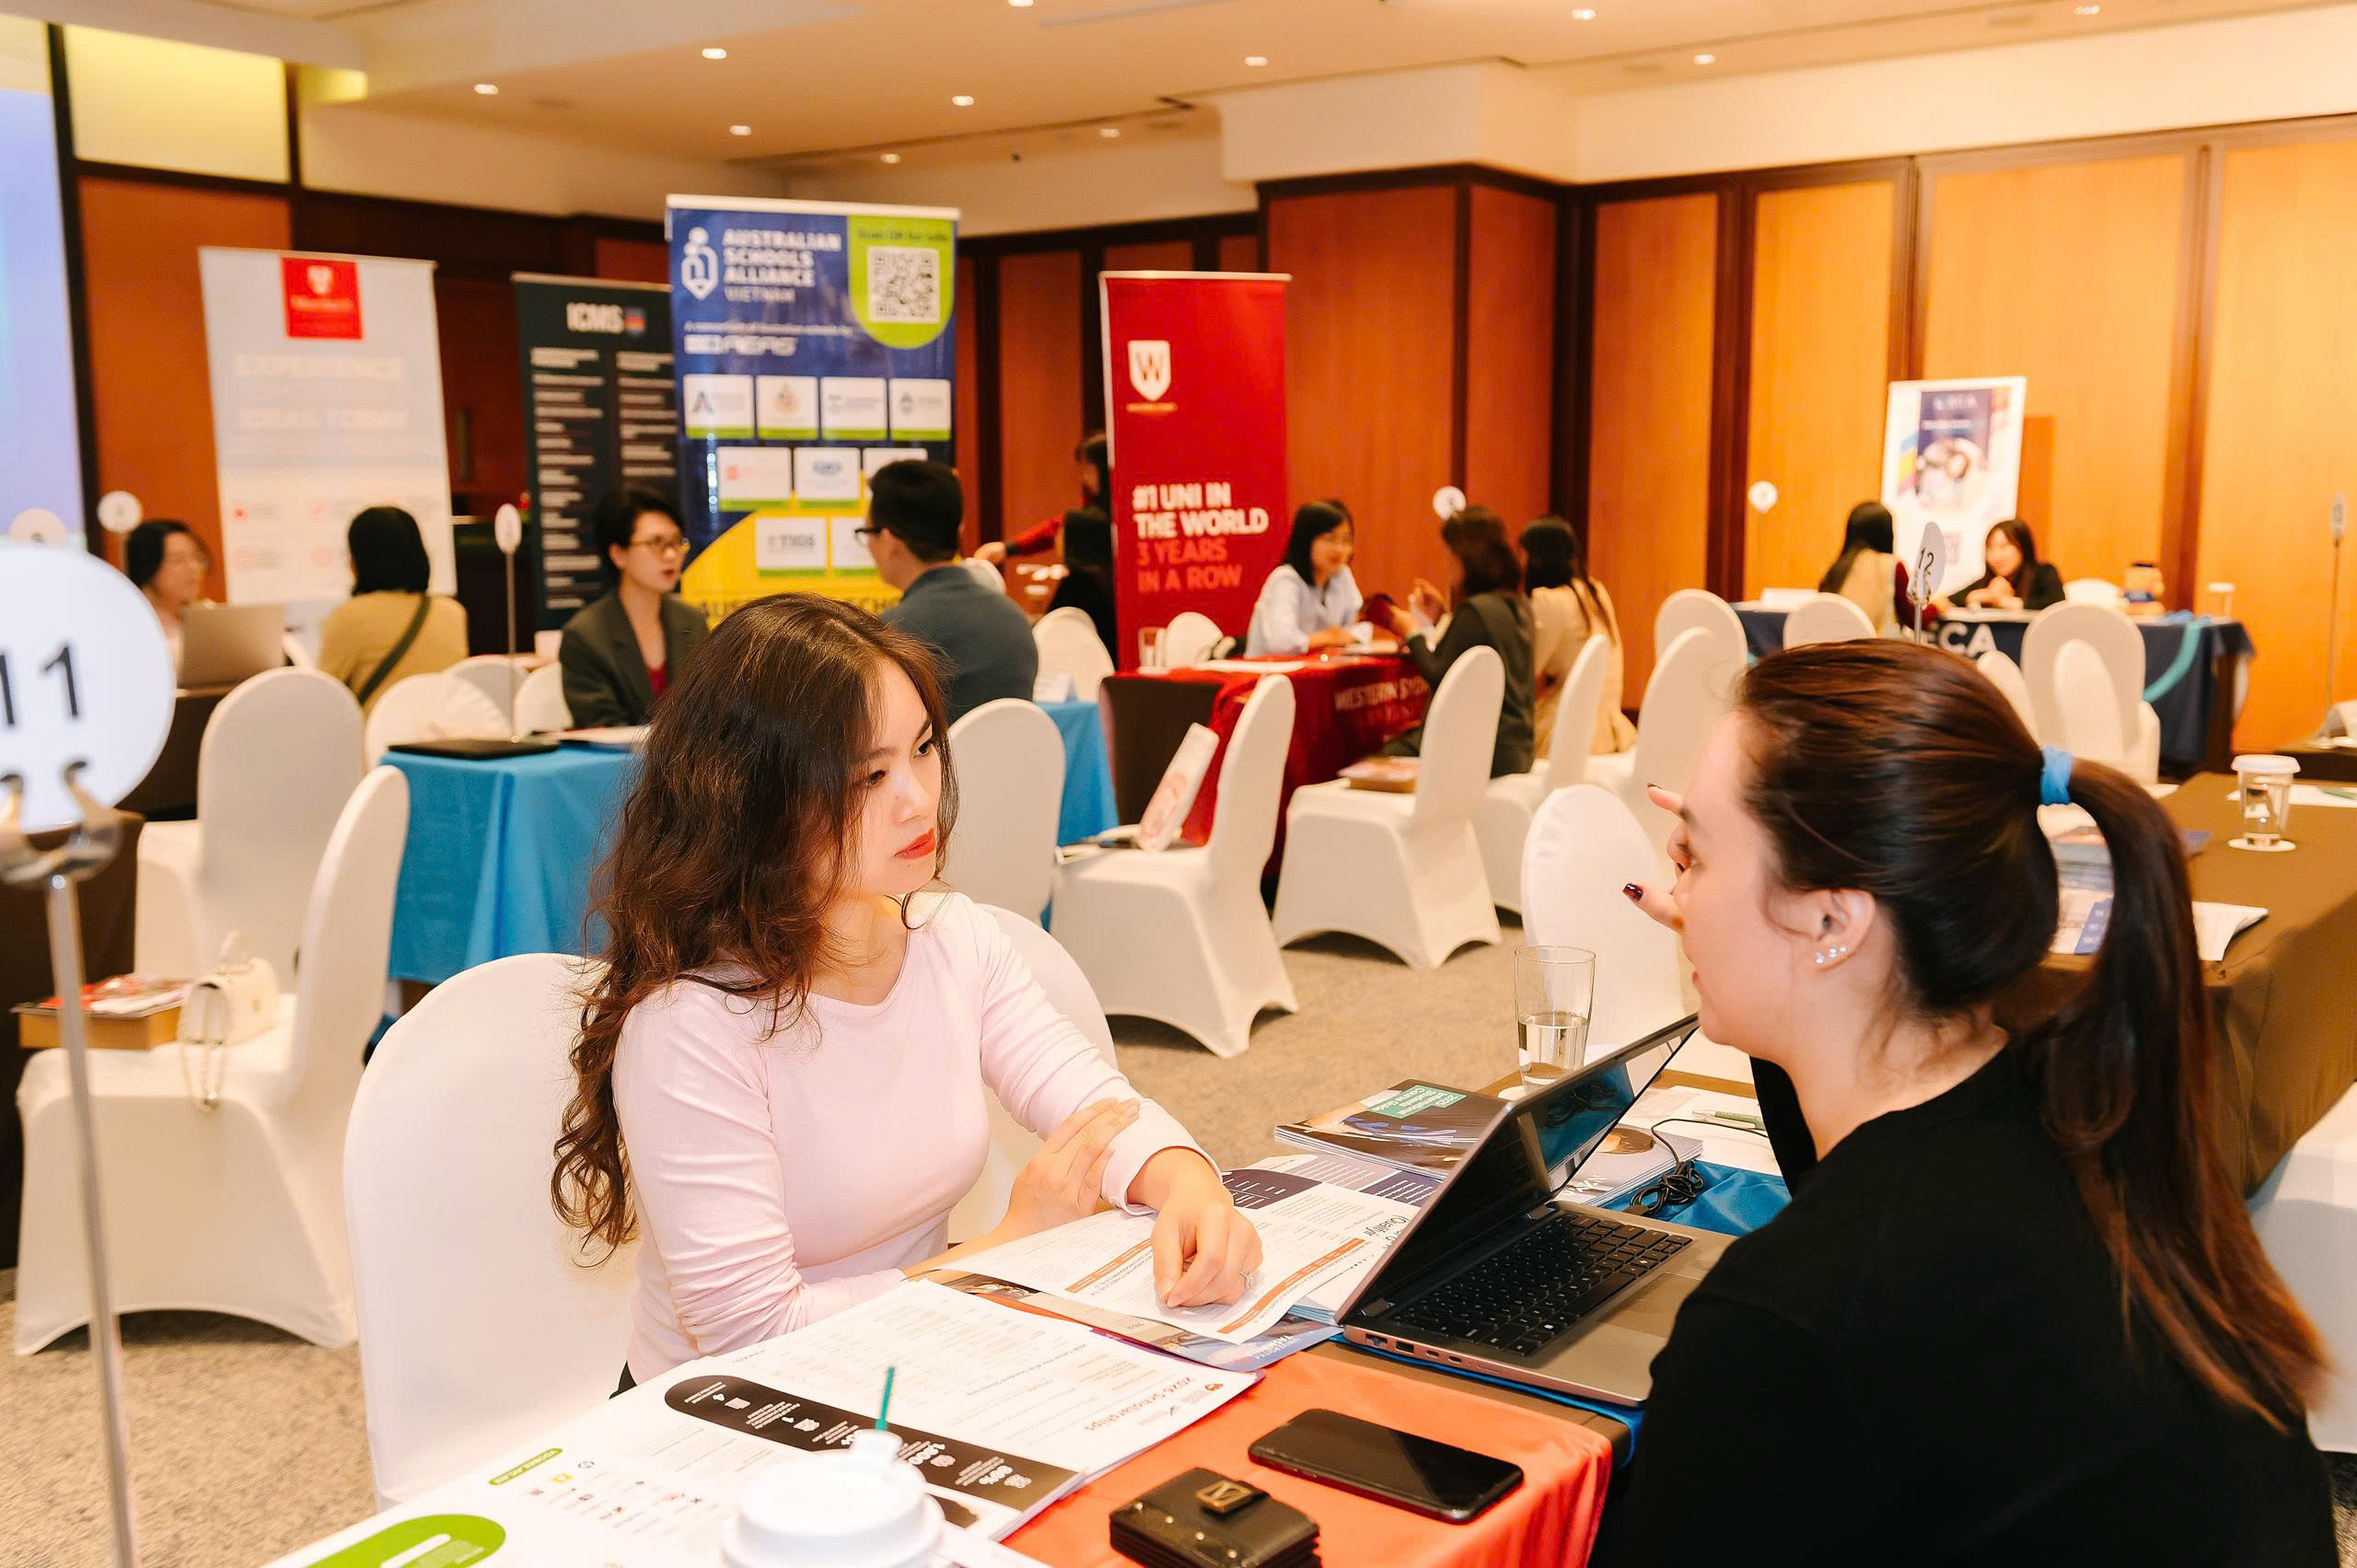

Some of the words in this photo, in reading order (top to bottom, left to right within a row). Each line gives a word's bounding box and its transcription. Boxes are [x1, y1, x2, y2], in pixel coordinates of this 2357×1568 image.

[723, 228, 842, 251] AUSTRALIAN
[723, 249, 815, 269] SCHOOLS
[723, 265, 816, 287] ALLIANCE
[566, 302, 624, 334] ICMS
[1132, 485, 1157, 511] #1
[1160, 483, 1202, 510] UNI
[1205, 482, 1231, 507] IN
[1133, 512, 1178, 540] THE
[1178, 507, 1270, 537] WORLD
[1137, 540, 1150, 566] 3
[1154, 538, 1228, 564] YEARS
[1918, 547, 1934, 575] 12
[1137, 570, 1159, 592] IN
[1165, 568, 1181, 591] A
[1186, 564, 1242, 589] ROW
[1085, 1393, 1162, 1431] Scholarships
